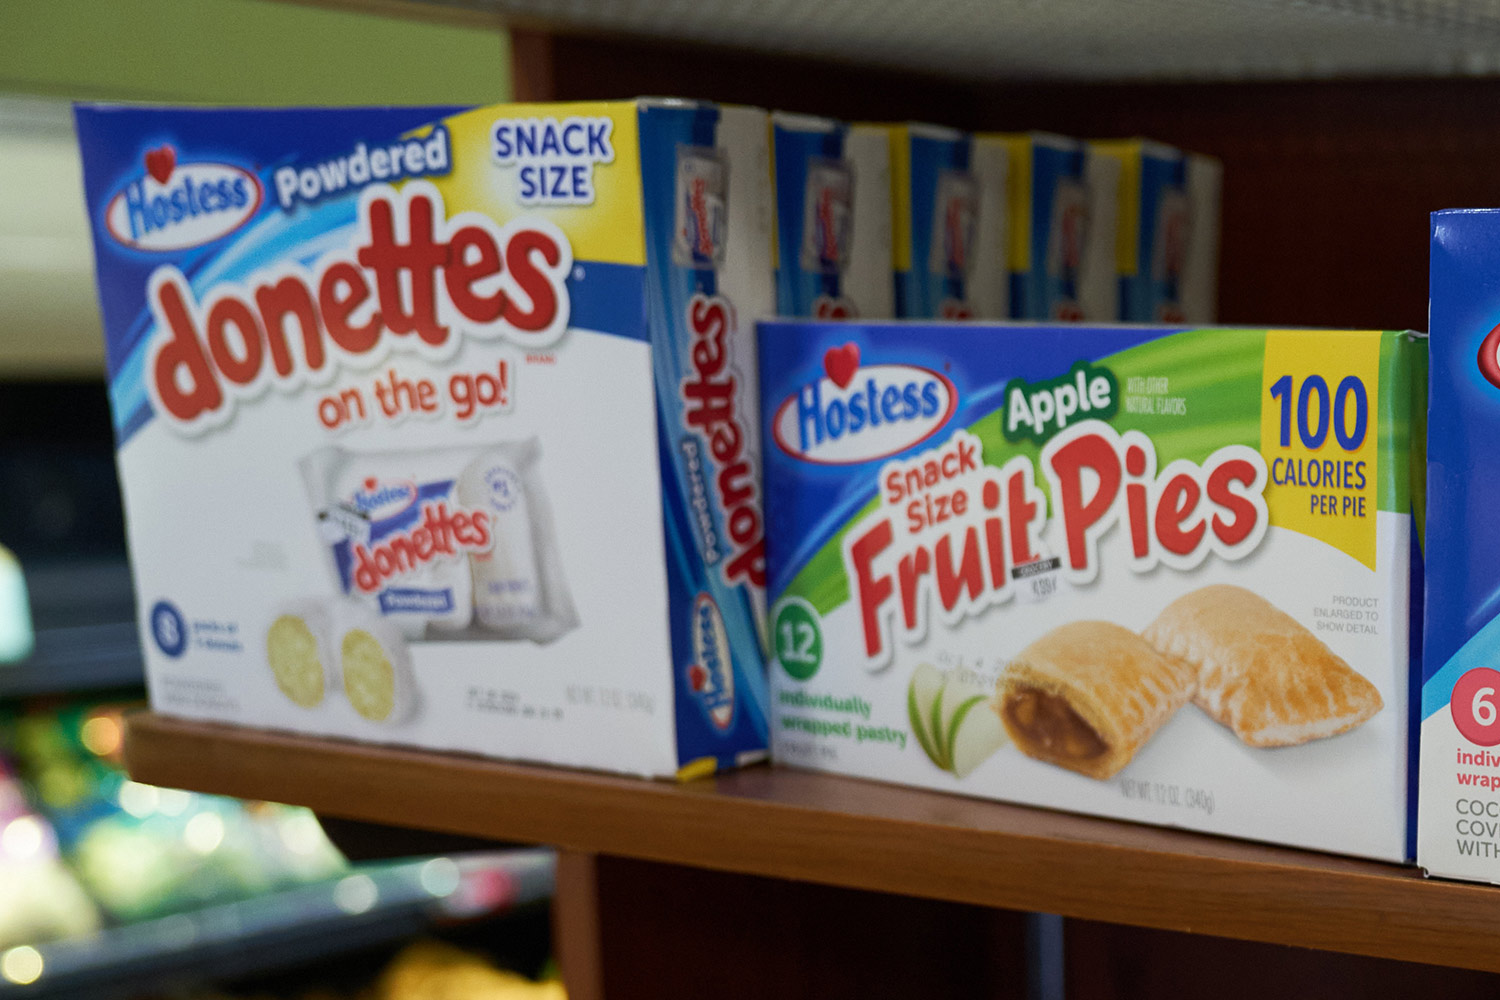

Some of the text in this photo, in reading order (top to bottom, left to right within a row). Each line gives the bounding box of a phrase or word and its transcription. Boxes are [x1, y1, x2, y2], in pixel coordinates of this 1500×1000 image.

[496, 124, 610, 158] SNACK
[277, 130, 447, 202] Powdered
[520, 165, 588, 198] SIZE
[124, 172, 249, 238] Hostess
[154, 195, 560, 421] donettes
[319, 361, 508, 428] on the go!
[799, 380, 939, 452] Hostess
[1008, 370, 1111, 434] Apple
[1270, 374, 1368, 451] 100
[886, 440, 977, 503] Snack
[1272, 457, 1366, 490] CALORIES
[907, 491, 968, 534] Size
[1310, 494, 1366, 517] PER PIE
[354, 503, 489, 592] donettes
[849, 432, 1259, 658] Fruit Pies
[1313, 607, 1379, 621] ENLARGED TO
[1332, 595, 1379, 608] PRODUCT
[781, 620, 817, 664] 12
[1316, 620, 1379, 635] SHOW DETAIL
[1472, 687, 1497, 726] 6
[856, 724, 907, 749] pastry
